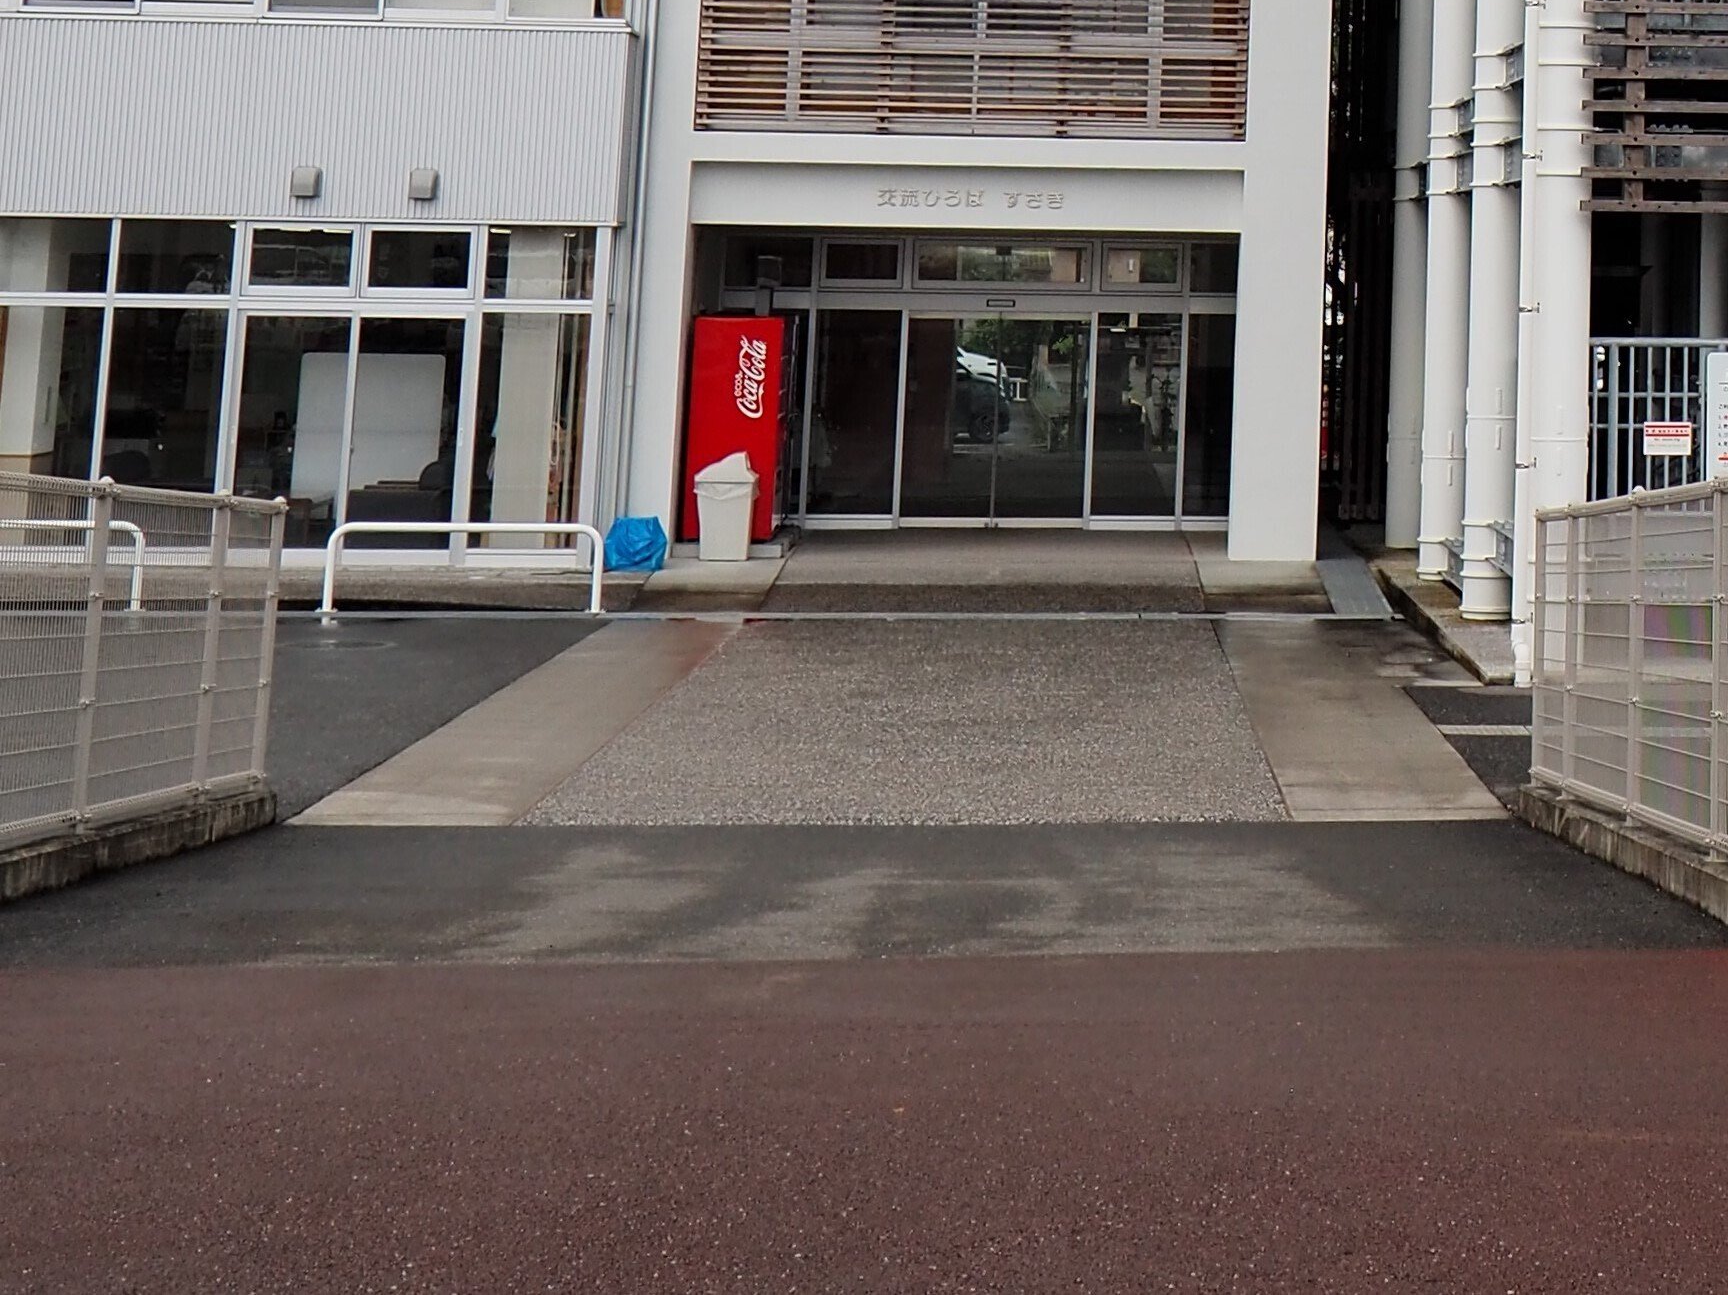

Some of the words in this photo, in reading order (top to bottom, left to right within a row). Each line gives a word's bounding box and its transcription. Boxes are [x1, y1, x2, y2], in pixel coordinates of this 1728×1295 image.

[877, 188, 984, 208] 交流ひろば
[1003, 191, 1065, 210] すさき
